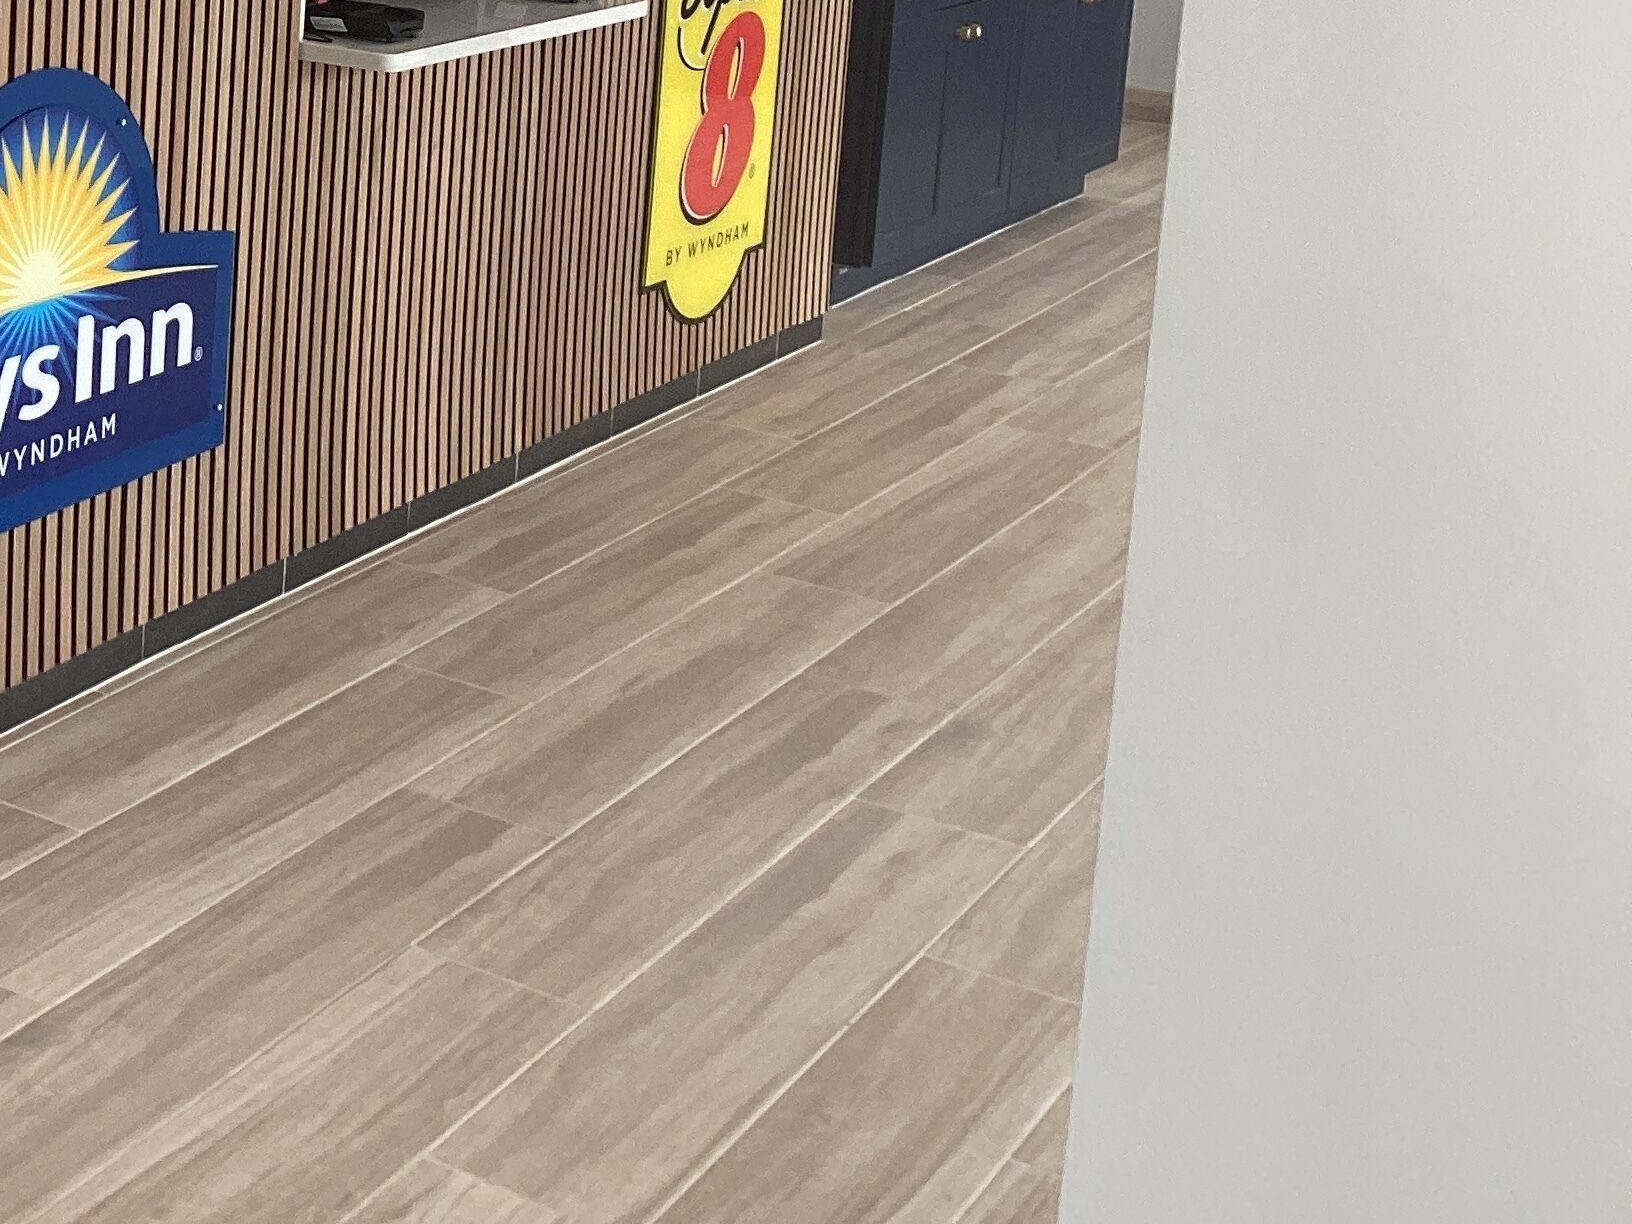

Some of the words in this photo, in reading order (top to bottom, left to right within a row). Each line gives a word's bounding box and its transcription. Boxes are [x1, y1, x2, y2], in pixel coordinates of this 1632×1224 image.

[679, 10, 766, 226] 8
[665, 246, 683, 266] BY
[687, 221, 749, 258] WYNDHAM
